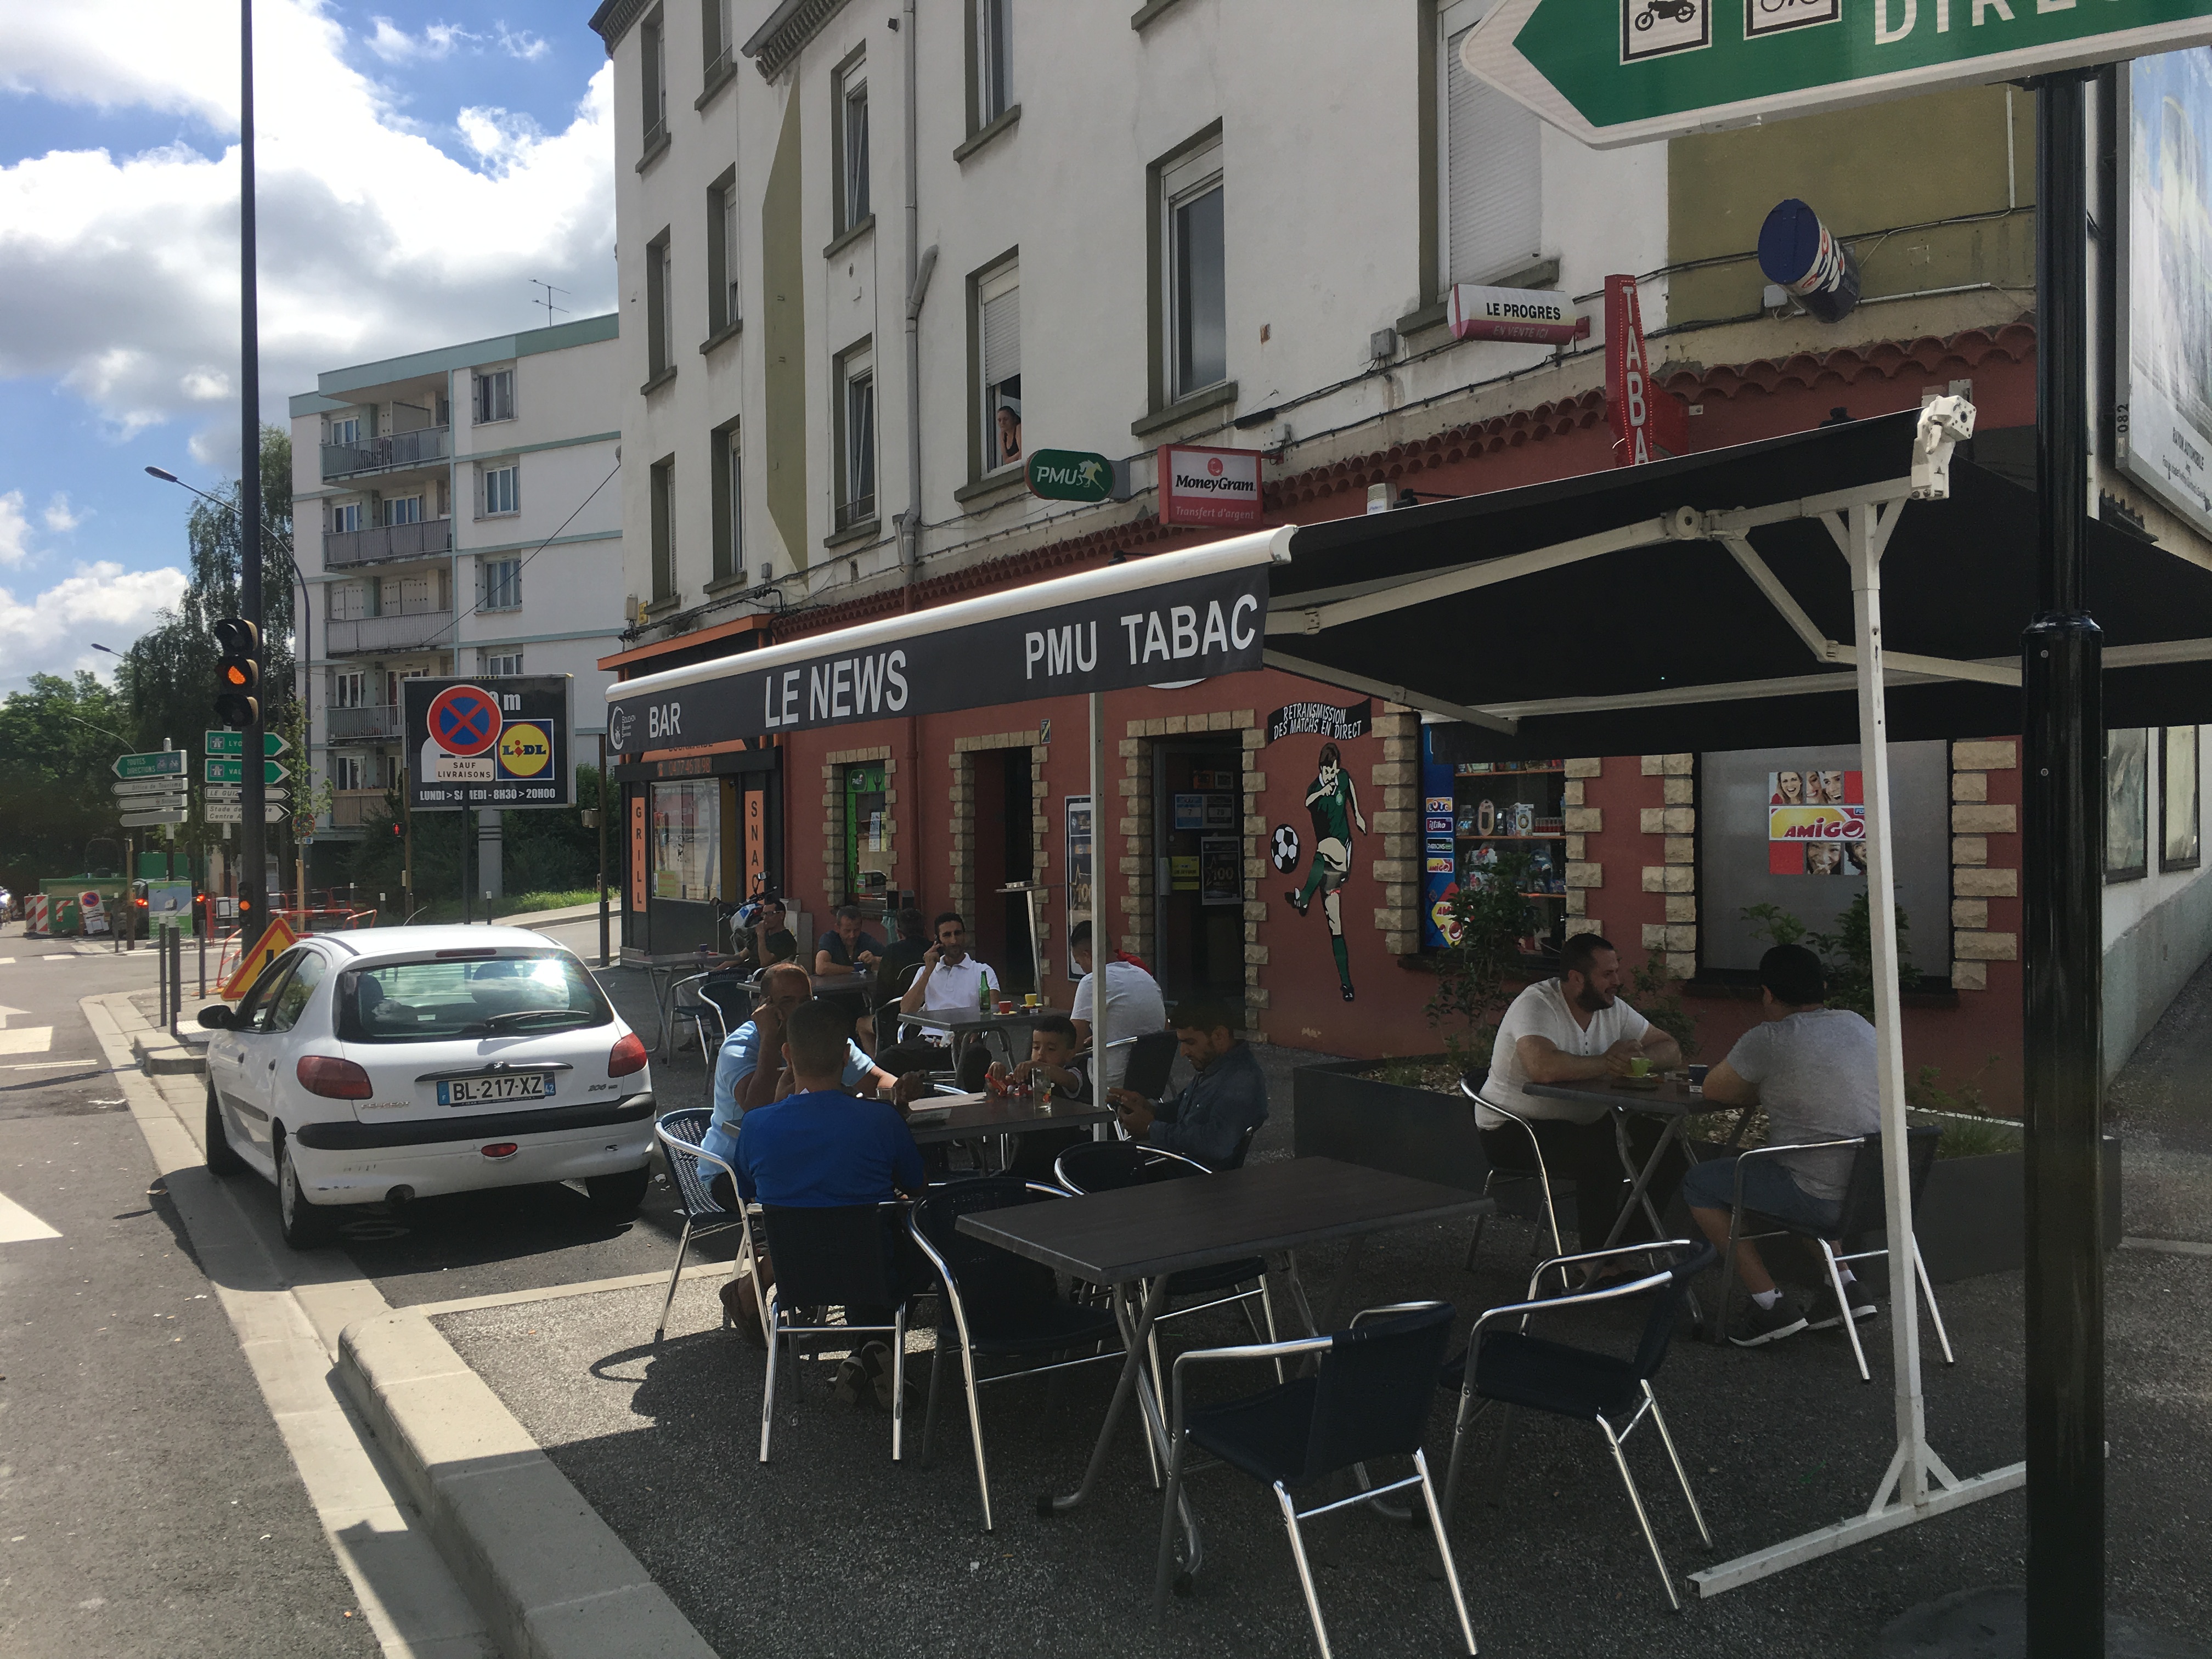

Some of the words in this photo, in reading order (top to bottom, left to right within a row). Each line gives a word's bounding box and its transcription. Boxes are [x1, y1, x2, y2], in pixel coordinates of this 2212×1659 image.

[1486, 302, 1500, 316] LE
[1493, 325, 1505, 335] EN
[1508, 326, 1533, 337] VENTE
[1536, 328, 1549, 338] ICI
[1622, 286, 1649, 466] TABA
[2117, 403, 2129, 433] 082
[1036, 466, 1077, 485] PMU
[1175, 475, 1254, 492] MoneyGram
[1176, 506, 1215, 518] Transfert
[1217, 507, 1254, 520] d'argent
[650, 702, 681, 738] BAR
[765, 670, 801, 728] LE
[809, 650, 909, 721] NEWS
[1025, 620, 1097, 680] PMU
[1120, 593, 1258, 666] TABAC
[1283, 703, 1346, 724] RETRANSMISSION
[1274, 721, 1288, 740] DES
[1289, 718, 1319, 735] MATCHS
[1321, 719, 1332, 736] EN
[1334, 720, 1362, 740] DIRECT
[127, 758, 146, 766] TOUTES
[127, 765, 155, 775] DIRECTIONS
[420, 791, 445, 800] LUNDI
[494, 789, 517, 799] 8H30
[526, 788, 556, 799] 20H00
[751, 800, 759, 893] SNAC
[1436, 905, 1454, 915] AM
[453, 1076, 543, 1101] BL-217-XZ
[544, 1084, 555, 1093] 42
